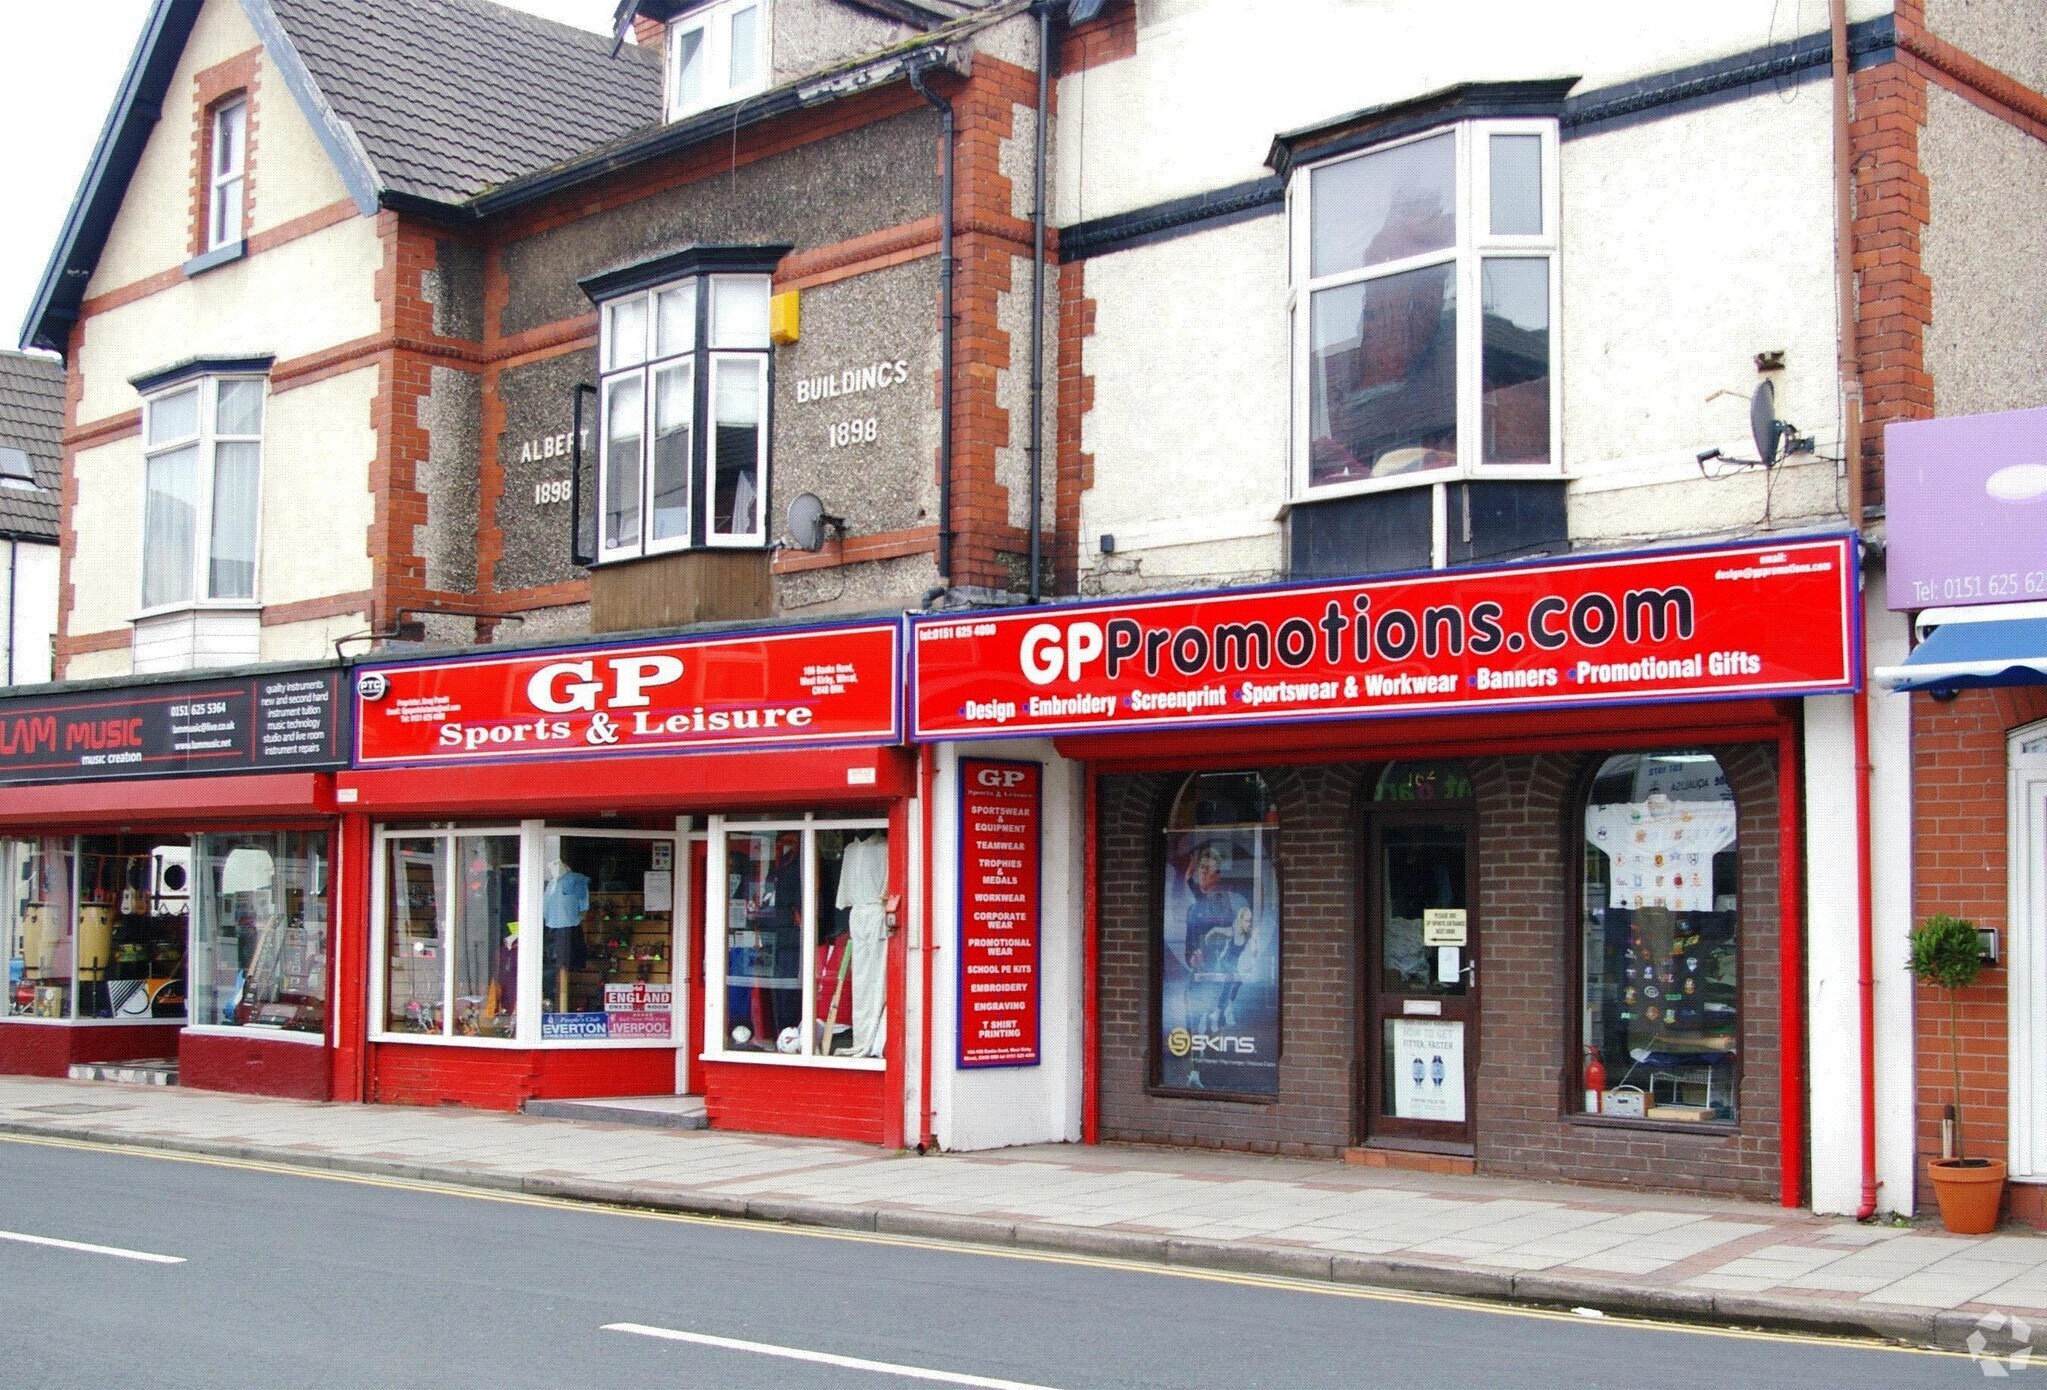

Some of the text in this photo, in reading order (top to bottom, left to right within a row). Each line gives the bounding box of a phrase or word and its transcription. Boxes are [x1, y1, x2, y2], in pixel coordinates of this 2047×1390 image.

[829, 416, 879, 448] 1898
[534, 480, 572, 506] 1898
[1913, 580, 1938, 601] Tel:
[1944, 576, 1983, 599] 0151
[1988, 573, 2019, 596] 625
[266, 680, 324, 694] quality instruments
[527, 655, 684, 712] GP
[966, 650, 1761, 723] Design Embroidery Screenprint Sportswear & Workwear Banners Promotional Gifts
[261, 690, 329, 706] new and second hand
[170, 701, 226, 716] 0151 625 5364
[267, 704, 321, 718] instrument tuition
[267, 718, 320, 731] music technology
[439, 703, 812, 750] Sports & Leisure
[66, 717, 144, 751] MUSIC
[263, 731, 325, 743] studio and live room
[264, 743, 320, 756] instrument repairs
[81, 751, 142, 765] music creation
[977, 769, 1026, 788] GP
[971, 805, 1030, 817] SPORTSWEAR
[975, 823, 1027, 834] EQUIPMENT
[976, 841, 1026, 851] TEAMWEAR
[978, 858, 1023, 869] TROPHIES
[982, 876, 1018, 885] MEDALS
[974, 893, 1026, 903] WORKWEAR
[973, 912, 1027, 922] CORPORATE
[987, 921, 1014, 930] WEAR
[968, 938, 1032, 948] PROMOTIONAL
[987, 947, 1014, 957] WEAR
[967, 964, 1032, 975] SCHOOL PE KITS
[970, 983, 1028, 993] EMBROIDERY
[608, 992, 671, 1003] ENGLAND
[973, 1001, 1026, 1012] ENGRAVING
[543, 1022, 606, 1034] EVERTON
[982, 1019, 1018, 1030] T SHIRT
[978, 1029, 1021, 1039] PRINTING
